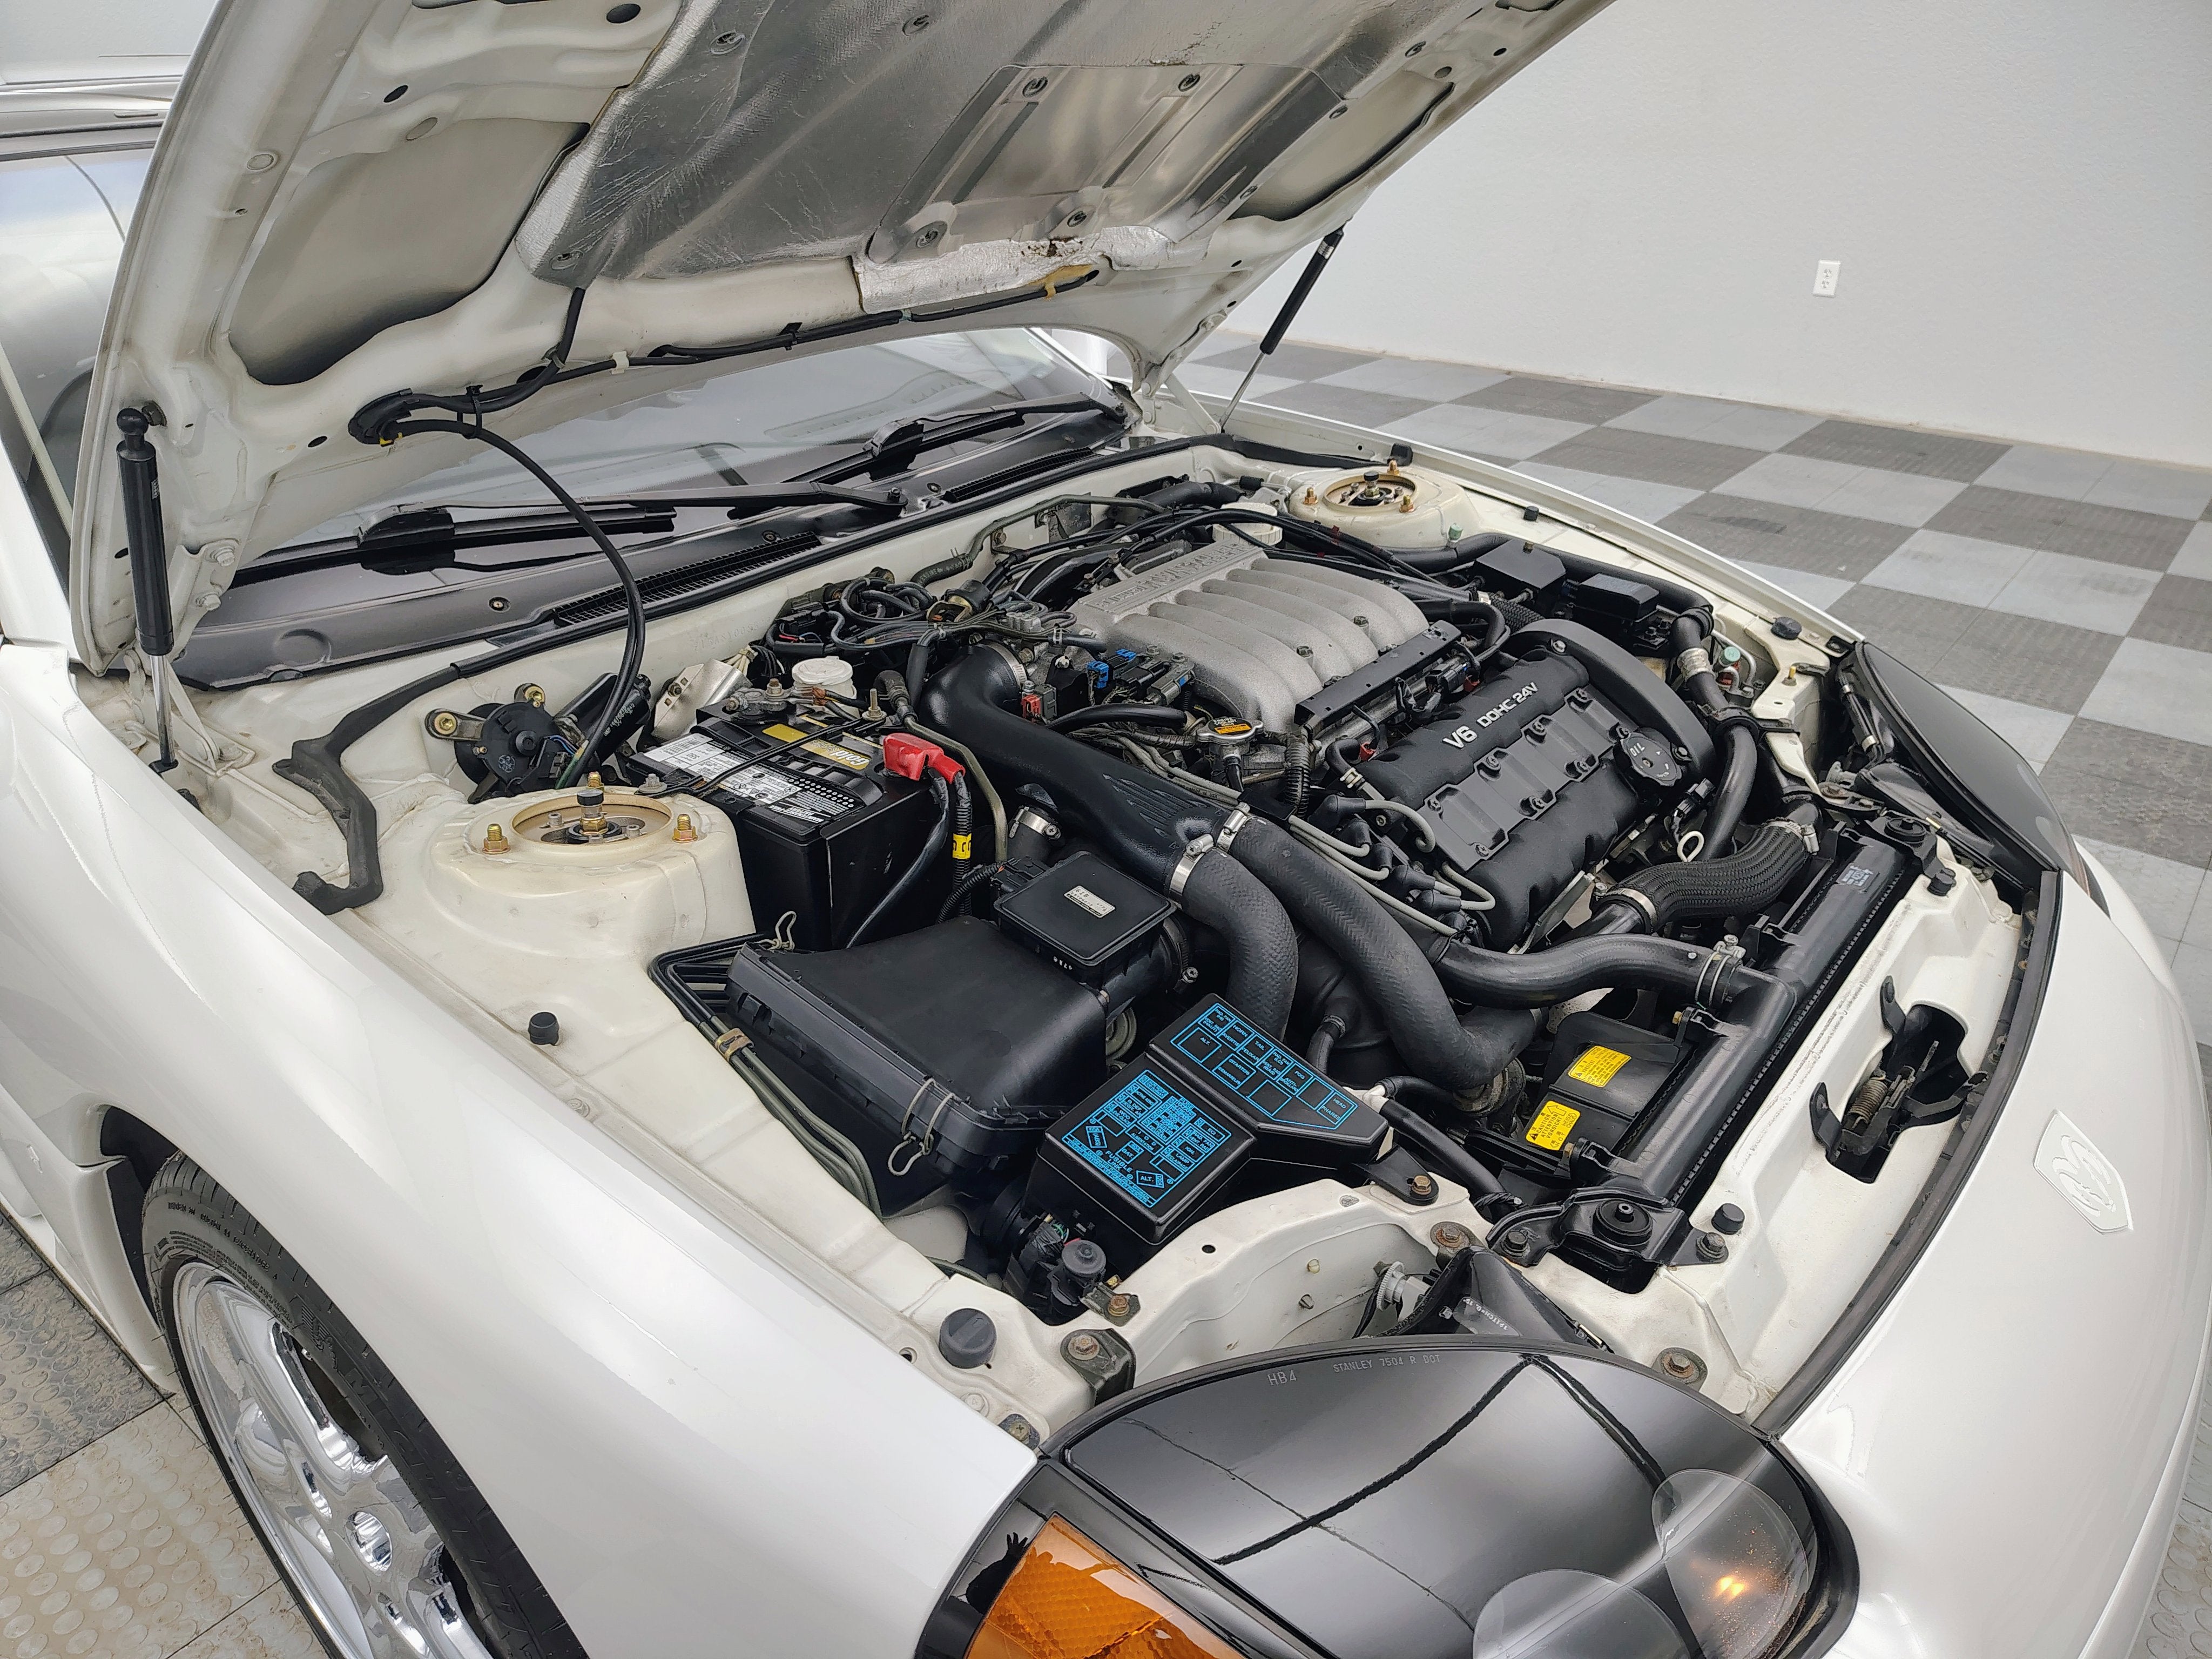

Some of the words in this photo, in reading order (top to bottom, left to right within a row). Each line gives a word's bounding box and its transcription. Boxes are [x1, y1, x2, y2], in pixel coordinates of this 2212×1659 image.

[1443, 726, 1478, 748] V6
[1476, 698, 1517, 727] DOHC
[1512, 682, 1538, 703] 24V
[1629, 743, 1645, 757] OIL
[829, 750, 870, 765] Gold
[1233, 1025, 1247, 1037] HORN
[1255, 1041, 1264, 1050] TAIL
[1294, 1071, 1305, 1079] FOG
[1179, 1098, 1194, 1110] FUSE
[1333, 1098, 1346, 1108] HEAD
[1321, 1105, 1340, 1121] PHARES
[1562, 1114, 1572, 1126] HEISS
[1536, 1114, 1550, 1133] CAUTION
[1541, 1113, 1557, 1137] ATTENTION
[1546, 1117, 1562, 1138] VORSICHT
[1566, 1116, 1576, 1128] CHAUD
[1122, 1149, 1134, 1158] BAT.
[1105, 1151, 1132, 1172] FUSIBLE
[1108, 1159, 1122, 1170] LINK
[1333, 1359, 1373, 1373] STANLEY
[1379, 1356, 1404, 1367] 7504
[1409, 1355, 1417, 1365] R
[1423, 1354, 1440, 1364] DOT
[1267, 1370, 1297, 1386] HB4
